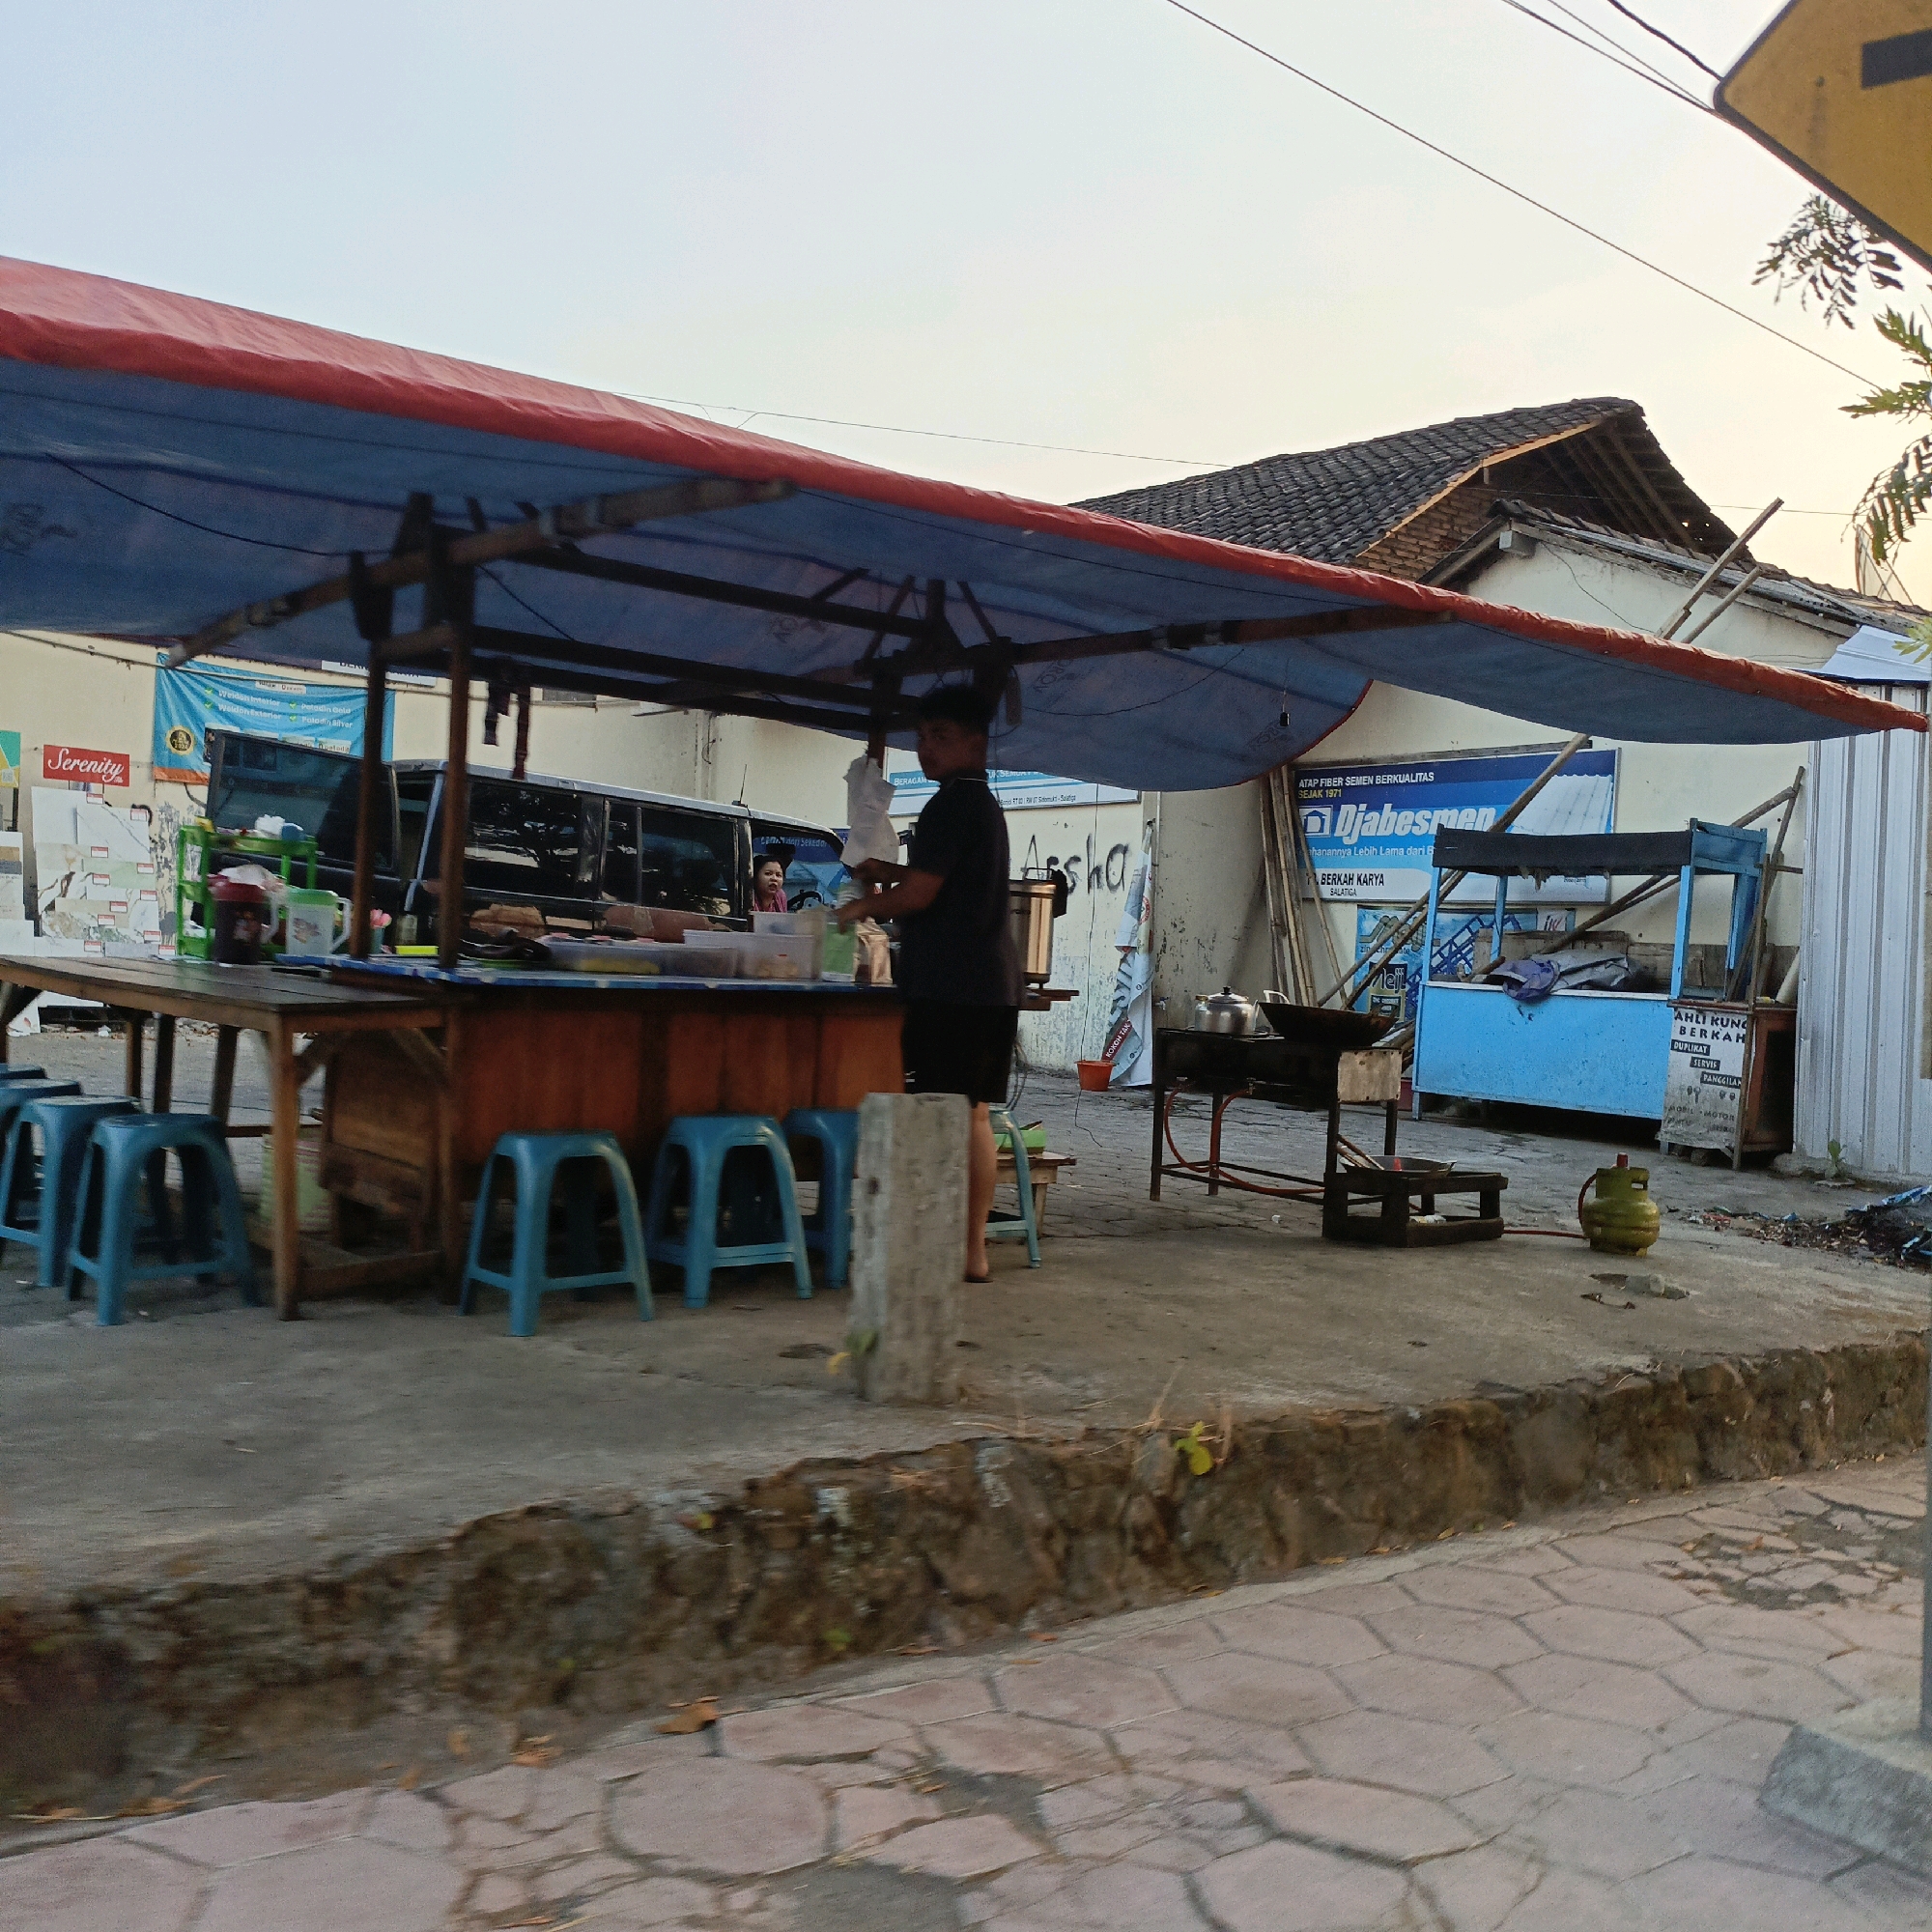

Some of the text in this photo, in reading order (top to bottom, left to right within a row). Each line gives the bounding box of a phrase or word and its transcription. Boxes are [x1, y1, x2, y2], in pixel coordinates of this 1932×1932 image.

[250, 696, 280, 707] Interior
[250, 709, 282, 720] Exterior
[332, 720, 354, 728] Silver
[47, 748, 124, 782] Serenity
[1298, 772, 1435, 788] ATAP FIBER SEMEN BERKUALITAS
[1298, 788, 1342, 799] SEJAK 1971
[1334, 804, 1497, 845] Djabesmen
[1353, 846, 1378, 857] Lebih
[1379, 846, 1404, 857] Lama
[1406, 845, 1425, 856] dari
[1321, 873, 1354, 886] BERKAH
[1356, 872, 1385, 886] KARYA
[1330, 888, 1358, 896] SALATIGA
[1674, 1010, 1707, 1025] AHLI
[1679, 1026, 1746, 1043] BERKAH
[1105, 1036, 1122, 1058] KOKOH
[1674, 1041, 1708, 1054] DUPLIKAT
[1693, 1059, 1718, 1069] SERVIS
